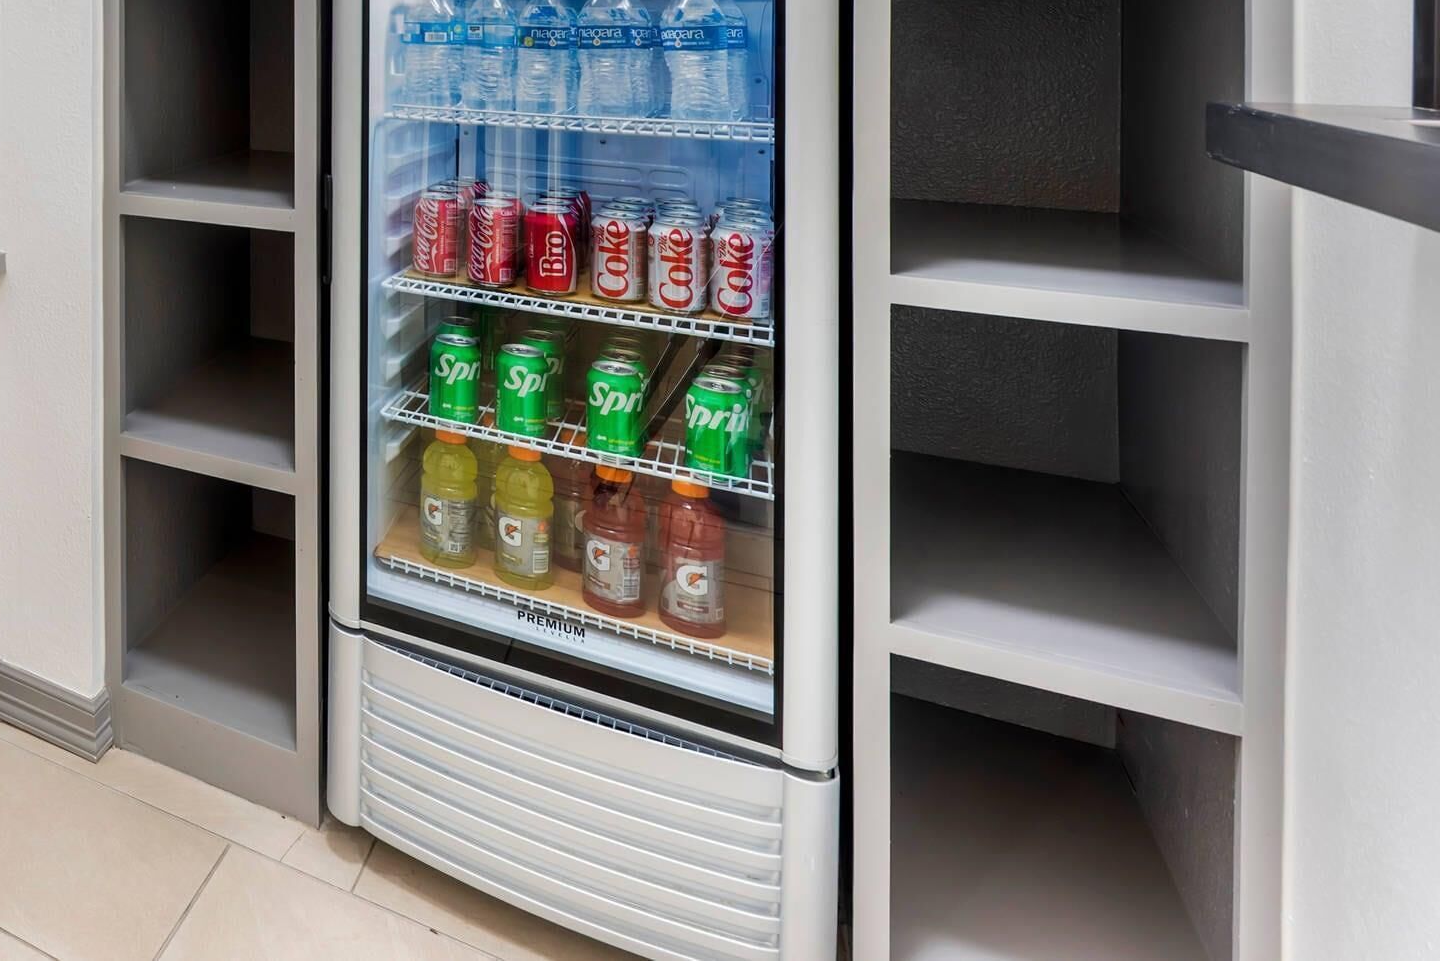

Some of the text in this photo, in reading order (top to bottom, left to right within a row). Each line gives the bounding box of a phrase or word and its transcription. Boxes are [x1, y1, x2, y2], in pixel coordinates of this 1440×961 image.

[540, 231, 566, 277] Bro
[597, 220, 630, 298] Coke
[659, 228, 694, 309] Coke
[717, 233, 755, 315] Coke
[498, 516, 522, 547] G
[586, 539, 611, 571] G
[676, 564, 708, 596] G
